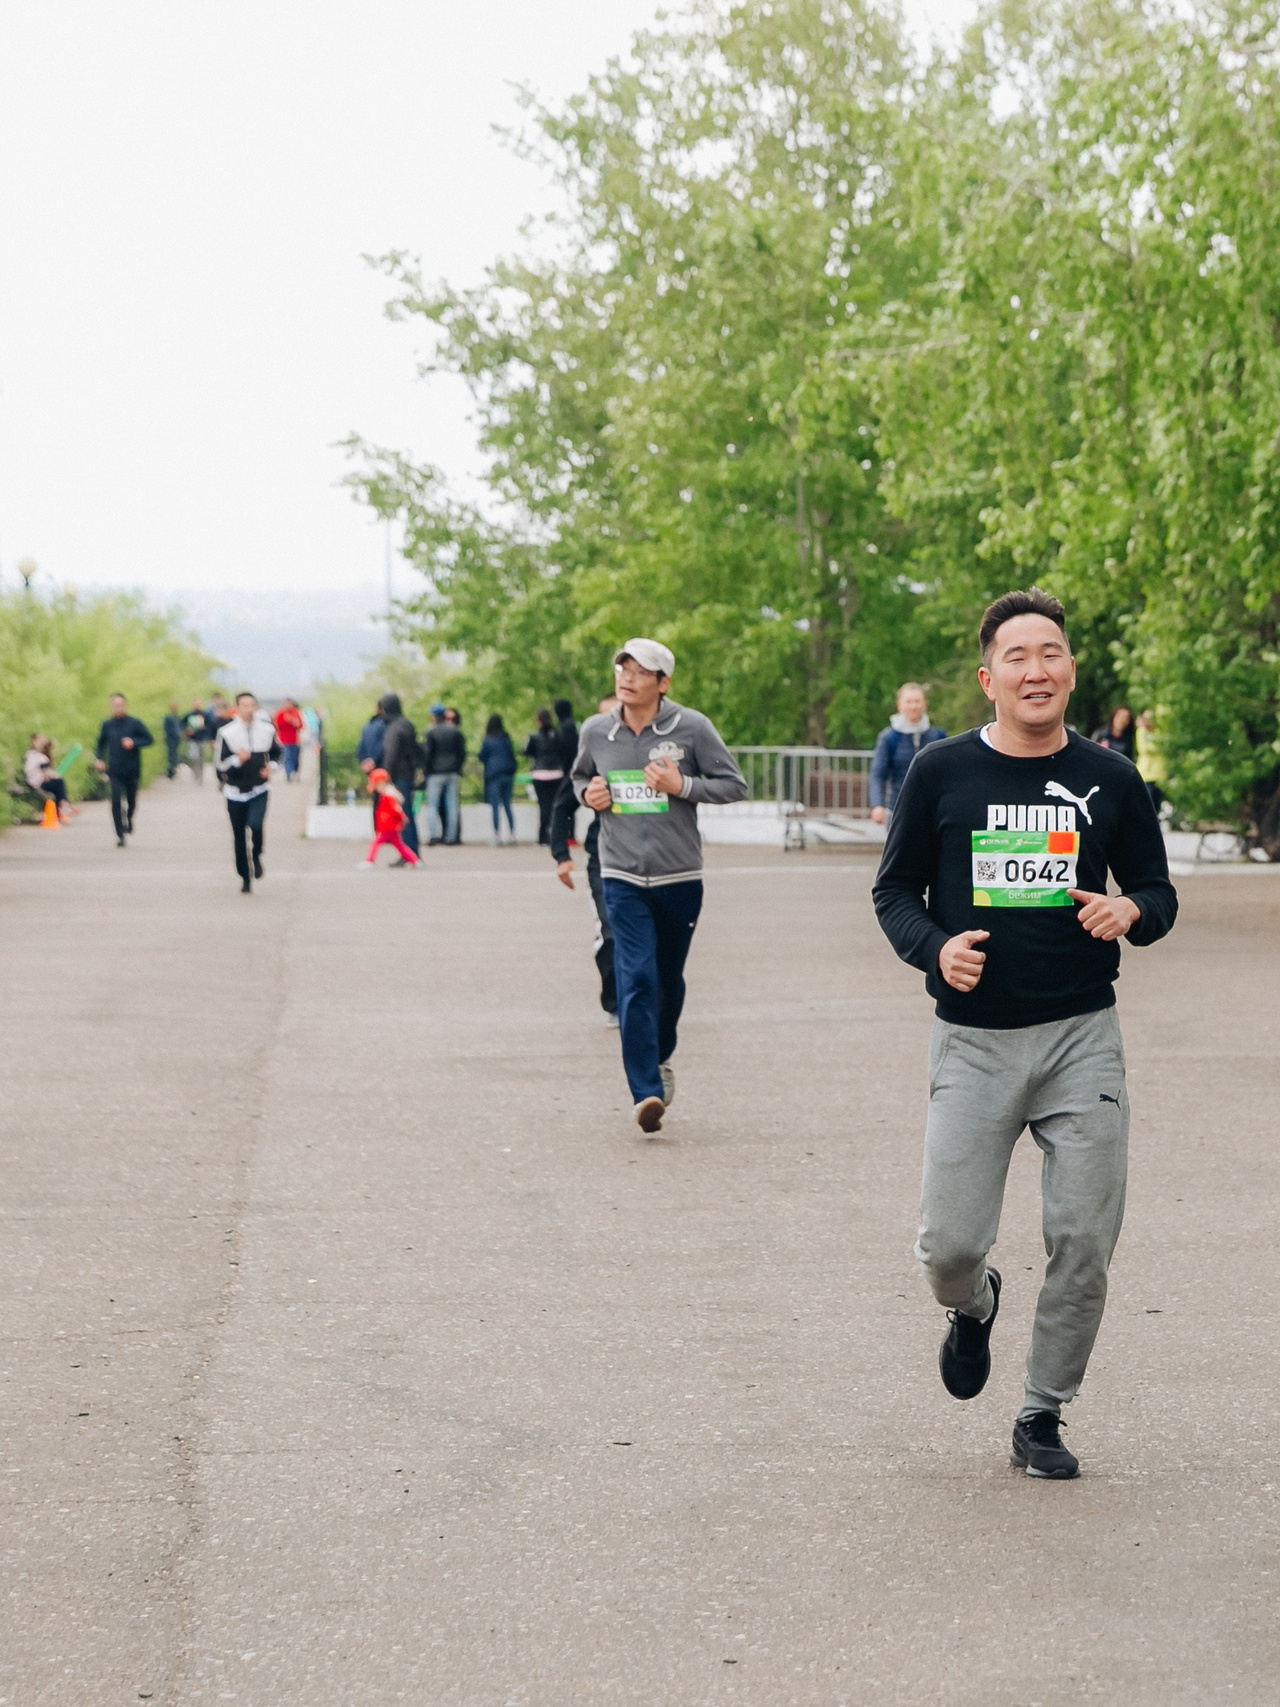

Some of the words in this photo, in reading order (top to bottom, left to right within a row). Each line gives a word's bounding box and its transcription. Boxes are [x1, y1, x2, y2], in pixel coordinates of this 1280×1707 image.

[987, 804, 1076, 832] PUMA
[1004, 859, 1070, 883] 0642
[1008, 889, 1042, 899] бежим
